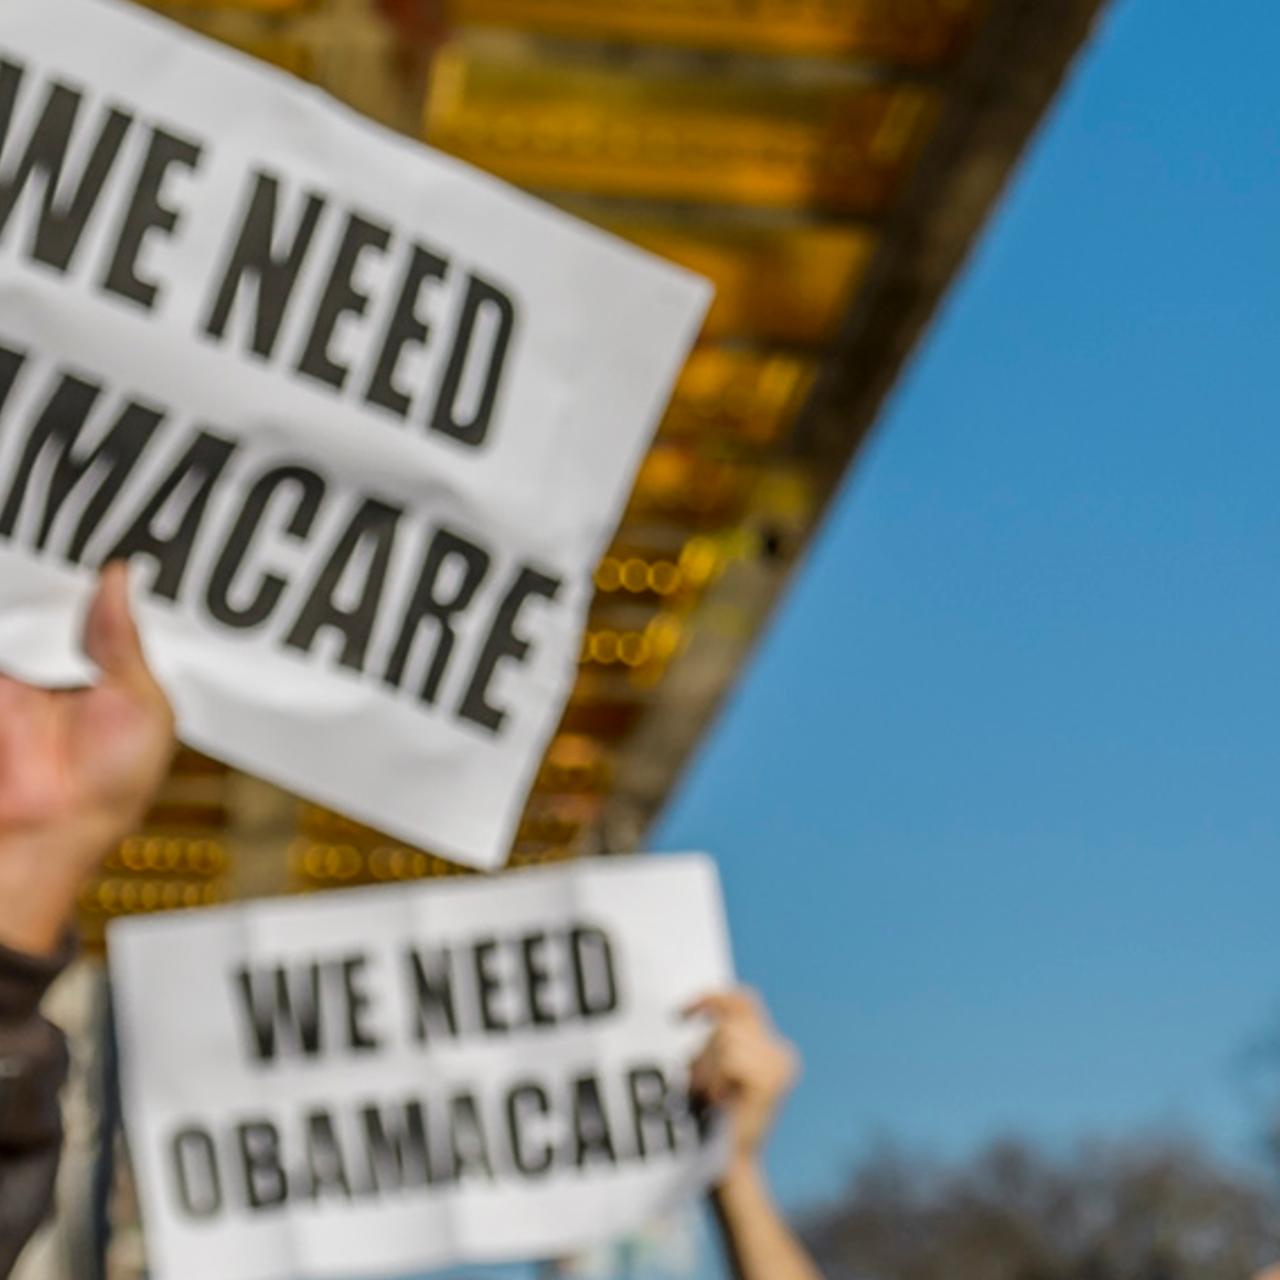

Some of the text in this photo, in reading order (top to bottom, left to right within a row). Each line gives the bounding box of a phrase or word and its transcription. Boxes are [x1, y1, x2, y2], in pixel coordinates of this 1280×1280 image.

[0, 58, 518, 448] WE NEED
[0, 347, 562, 734] MACARE
[235, 925, 622, 1067] WE NEED
[170, 1063, 708, 1223] OBAMACAR
